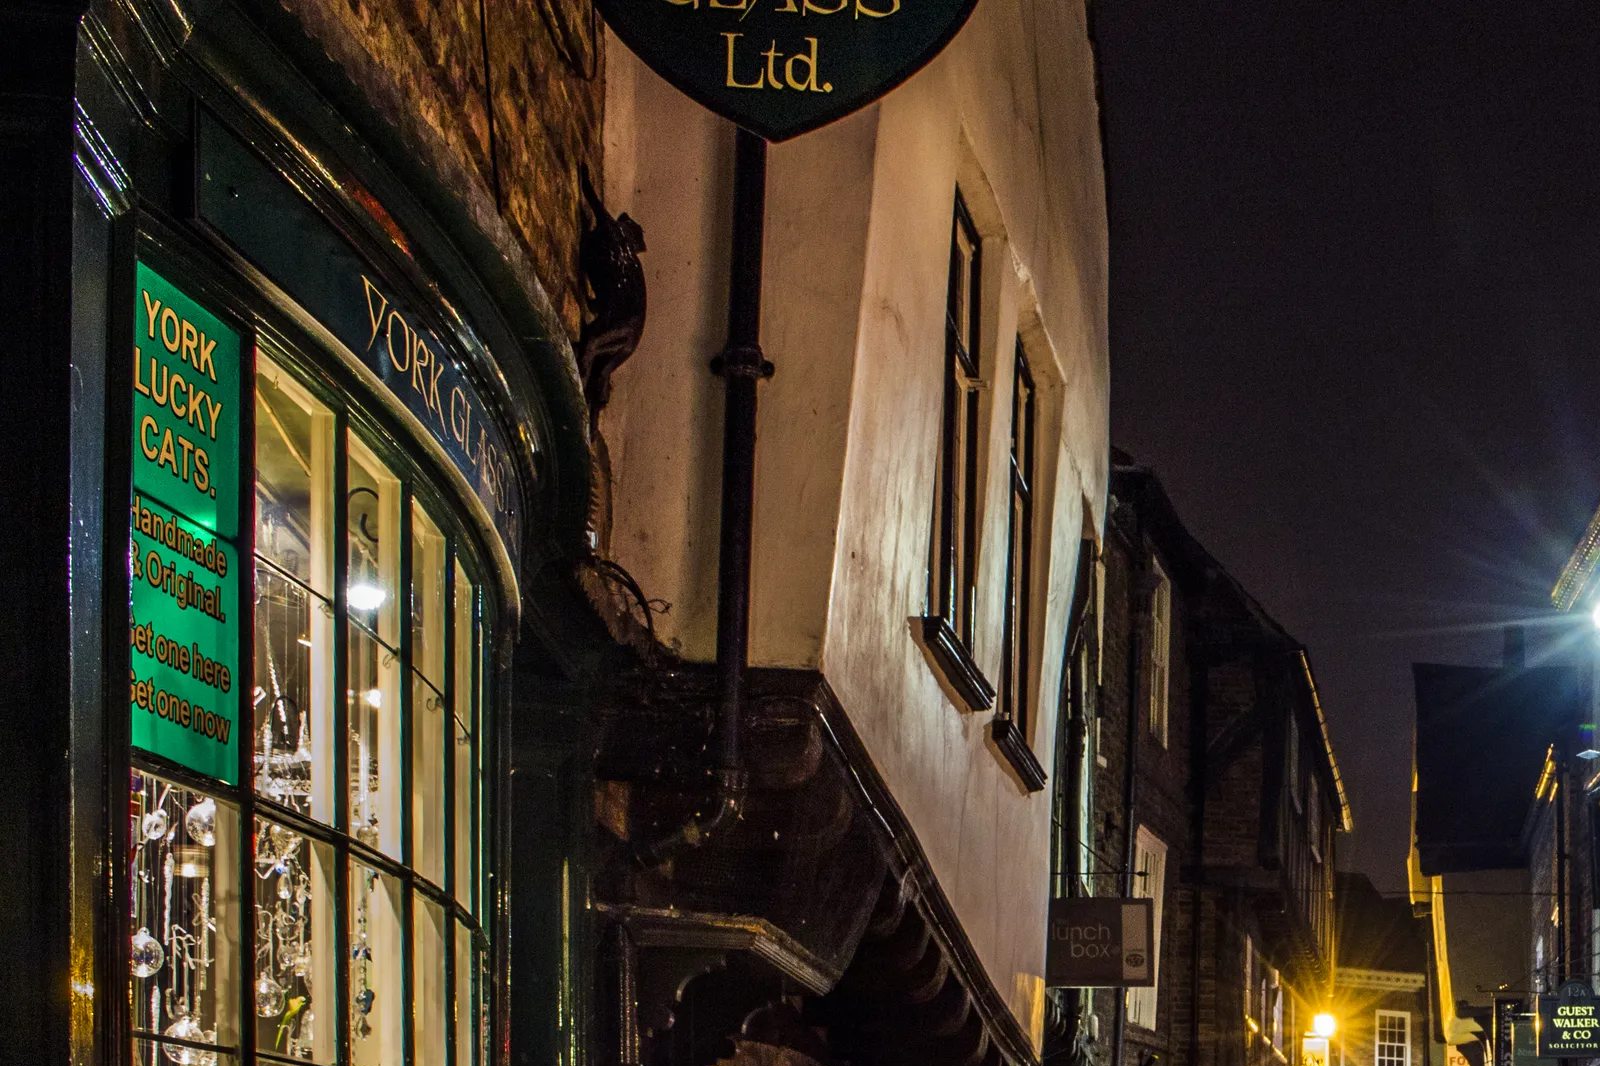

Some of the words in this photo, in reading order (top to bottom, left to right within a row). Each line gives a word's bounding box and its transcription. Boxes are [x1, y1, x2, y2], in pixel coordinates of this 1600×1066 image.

[720, 32, 833, 93] Ltd.
[142, 288, 218, 384] YORK
[134, 346, 223, 442] LUCKY
[361, 274, 449, 440] YORK
[450, 386, 505, 512] GLASS
[140, 415, 217, 499] CATS.
[131, 495, 227, 577] Handmade
[146, 551, 226, 624] Original.
[155, 634, 190, 673] one
[193, 642, 231, 693] here
[156, 689, 191, 729] one
[193, 705, 231, 745] now
[1051, 922, 1111, 940] lunch
[1070, 940, 1111, 958] box
[1552, 1018, 1600, 1028] WALKER
[1557, 1005, 1595, 1016] GUEST
[1562, 1030, 1571, 1040] &
[1573, 1030, 1591, 1040] CO
